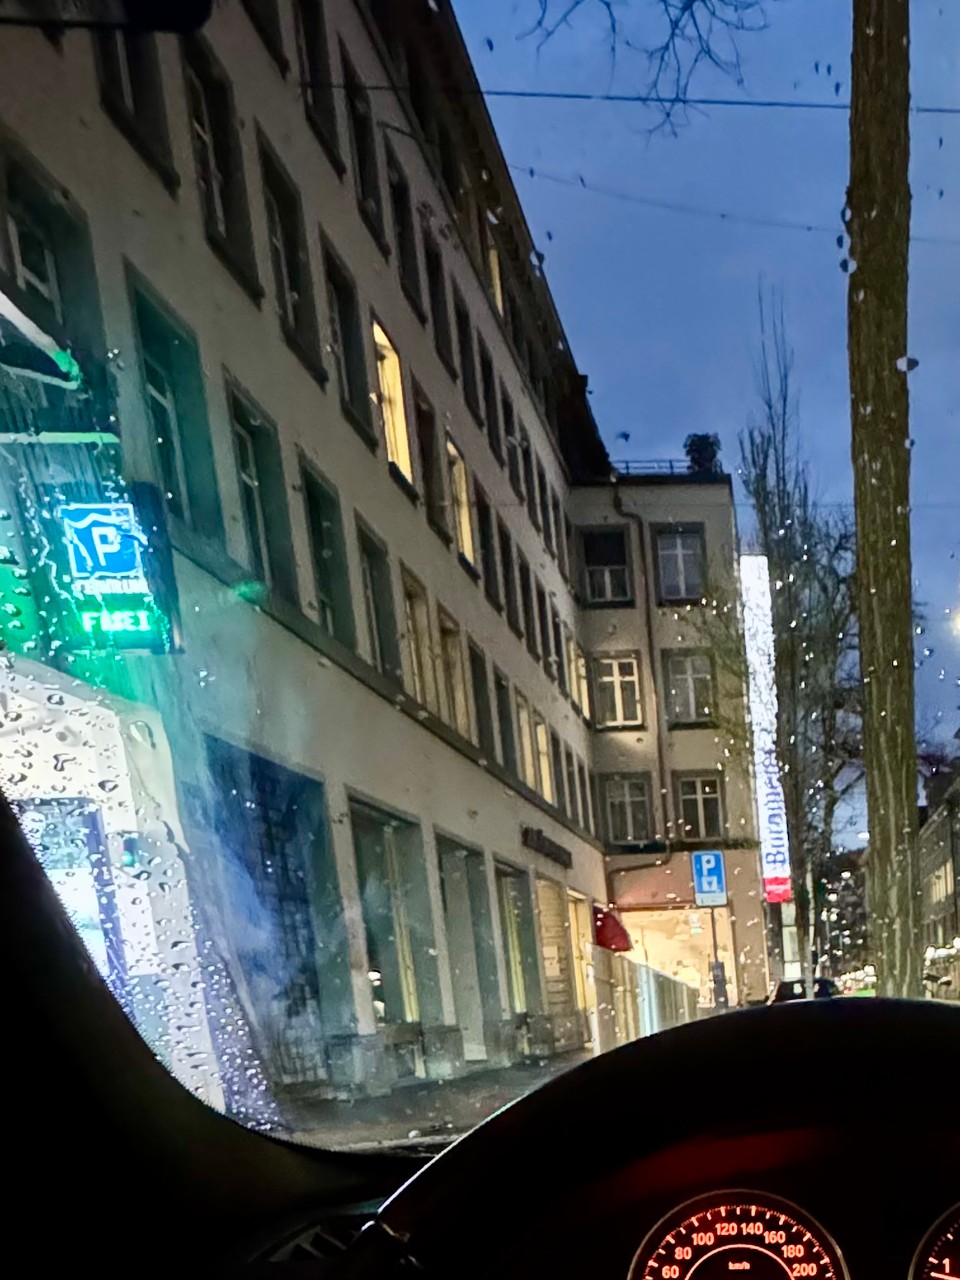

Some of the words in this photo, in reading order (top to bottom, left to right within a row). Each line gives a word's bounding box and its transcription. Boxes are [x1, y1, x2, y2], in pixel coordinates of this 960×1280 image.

[90, 526, 121, 567] P
[701, 855, 716, 876] P
[715, 1222, 738, 1236] 120
[740, 1221, 764, 1236] 140
[691, 1232, 715, 1246] 100
[763, 1231, 786, 1245] 160
[674, 1247, 692, 1260] 80
[781, 1245, 805, 1258] 180
[661, 1265, 680, 1279] 60
[792, 1263, 817, 1277] 200
[942, 1257, 950, 1274] 1
